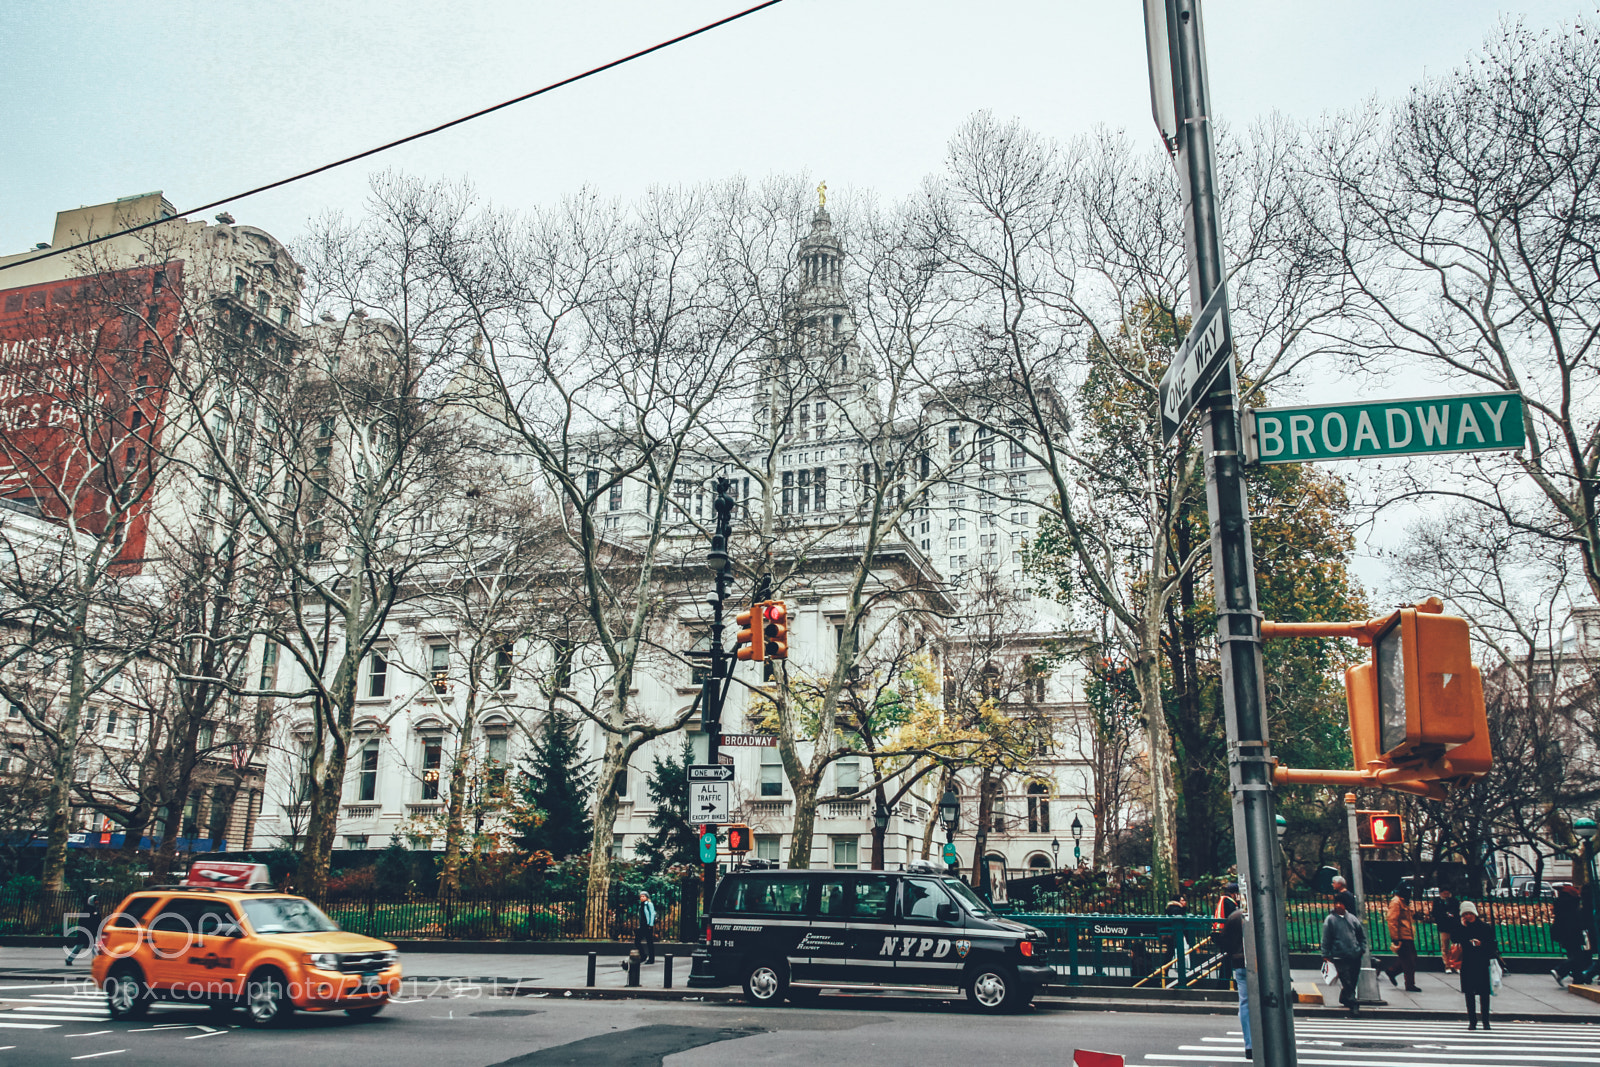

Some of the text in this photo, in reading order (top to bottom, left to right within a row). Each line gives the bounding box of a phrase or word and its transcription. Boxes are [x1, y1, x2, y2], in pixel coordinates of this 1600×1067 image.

[1169, 367, 1188, 414] ONE
[1194, 318, 1217, 374] WAY
[1258, 400, 1509, 457] BROADWAY
[724, 735, 773, 746] BROADWAY
[694, 769, 728, 777] ONE WAY
[701, 784, 718, 793] ALL
[697, 794, 722, 802] TRAFFIC
[692, 813, 710, 821] EXCEPT
[1094, 924, 1128, 936] Subway
[879, 936, 951, 958] NYPD
